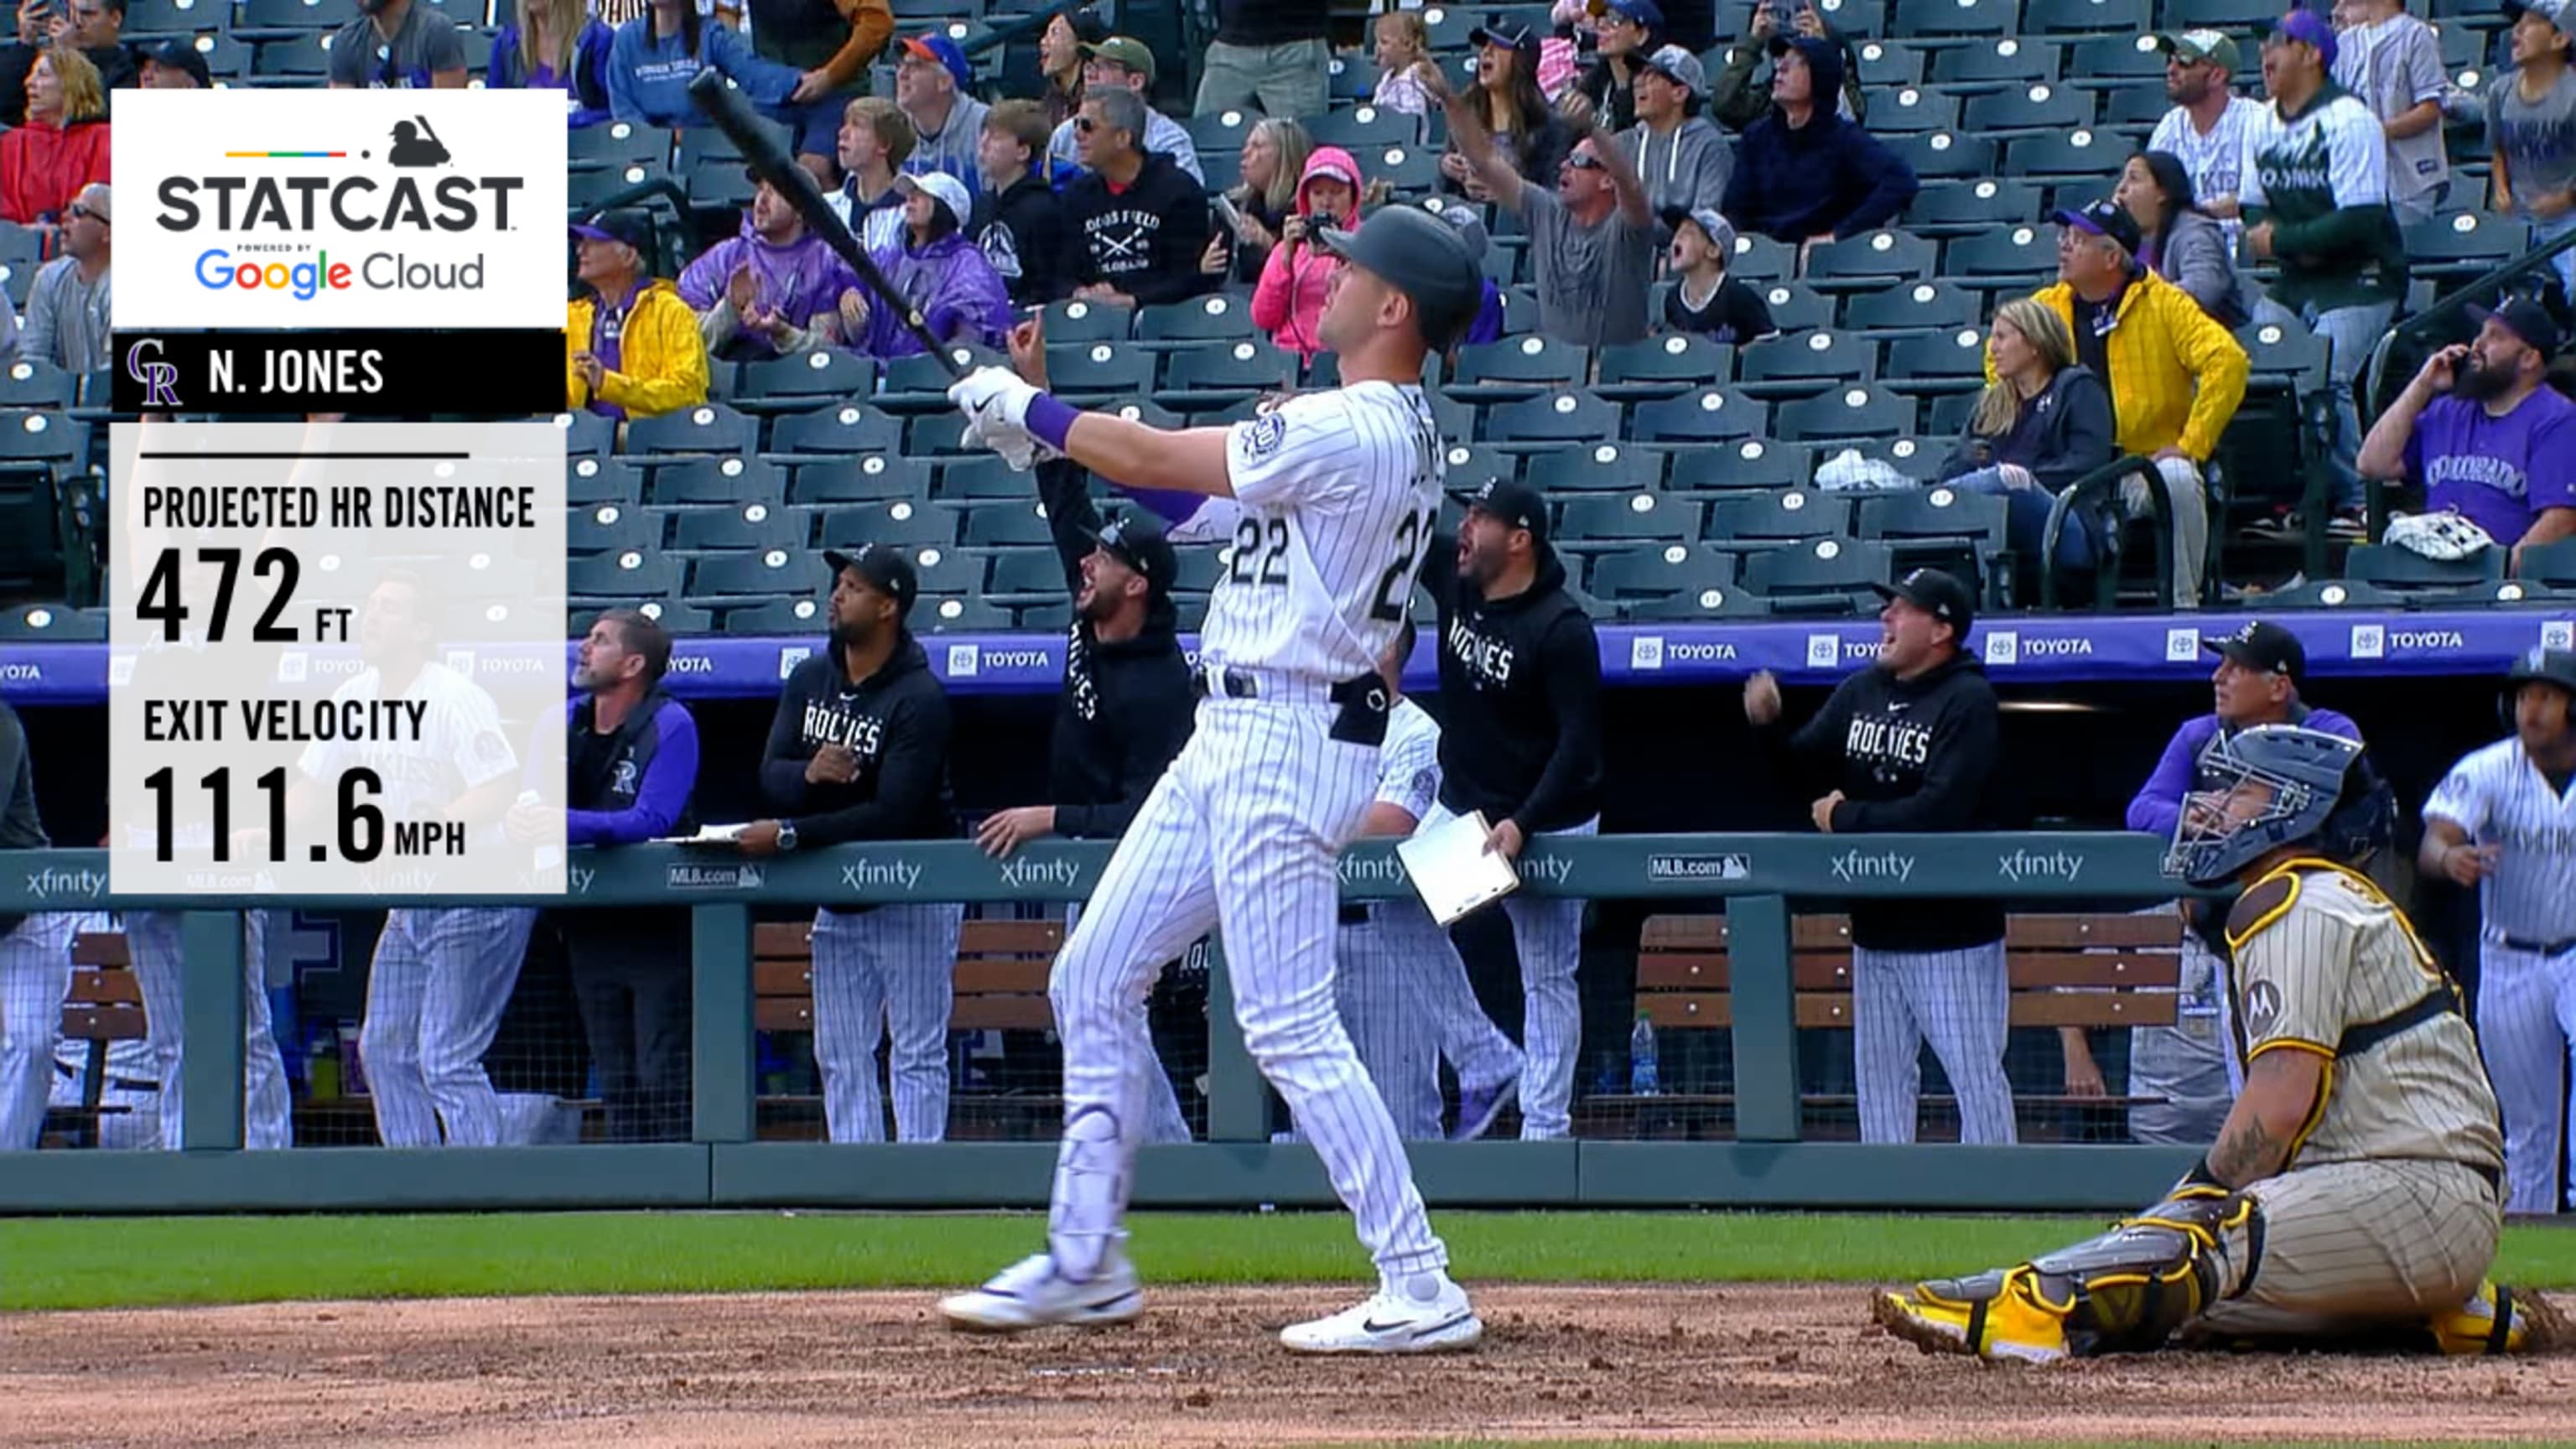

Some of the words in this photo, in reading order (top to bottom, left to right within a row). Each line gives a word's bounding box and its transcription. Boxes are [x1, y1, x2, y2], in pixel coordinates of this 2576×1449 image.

[1231, 517, 1290, 585] 22
[1668, 642, 1737, 660] TOYOTA
[2023, 638, 2093, 656] TOYOTA
[2389, 631, 2464, 649] TOYOTA
[983, 651, 1049, 667] TOYOTA
[841, 859, 922, 890] xfinity
[1000, 858, 1080, 887] xfinity
[1653, 860, 1722, 875] MLB.com
[1831, 849, 1914, 882] xfinity
[1998, 848, 2084, 881] xfinity
[26, 866, 106, 897] xfinity
[671, 869, 737, 884] MLB.com
